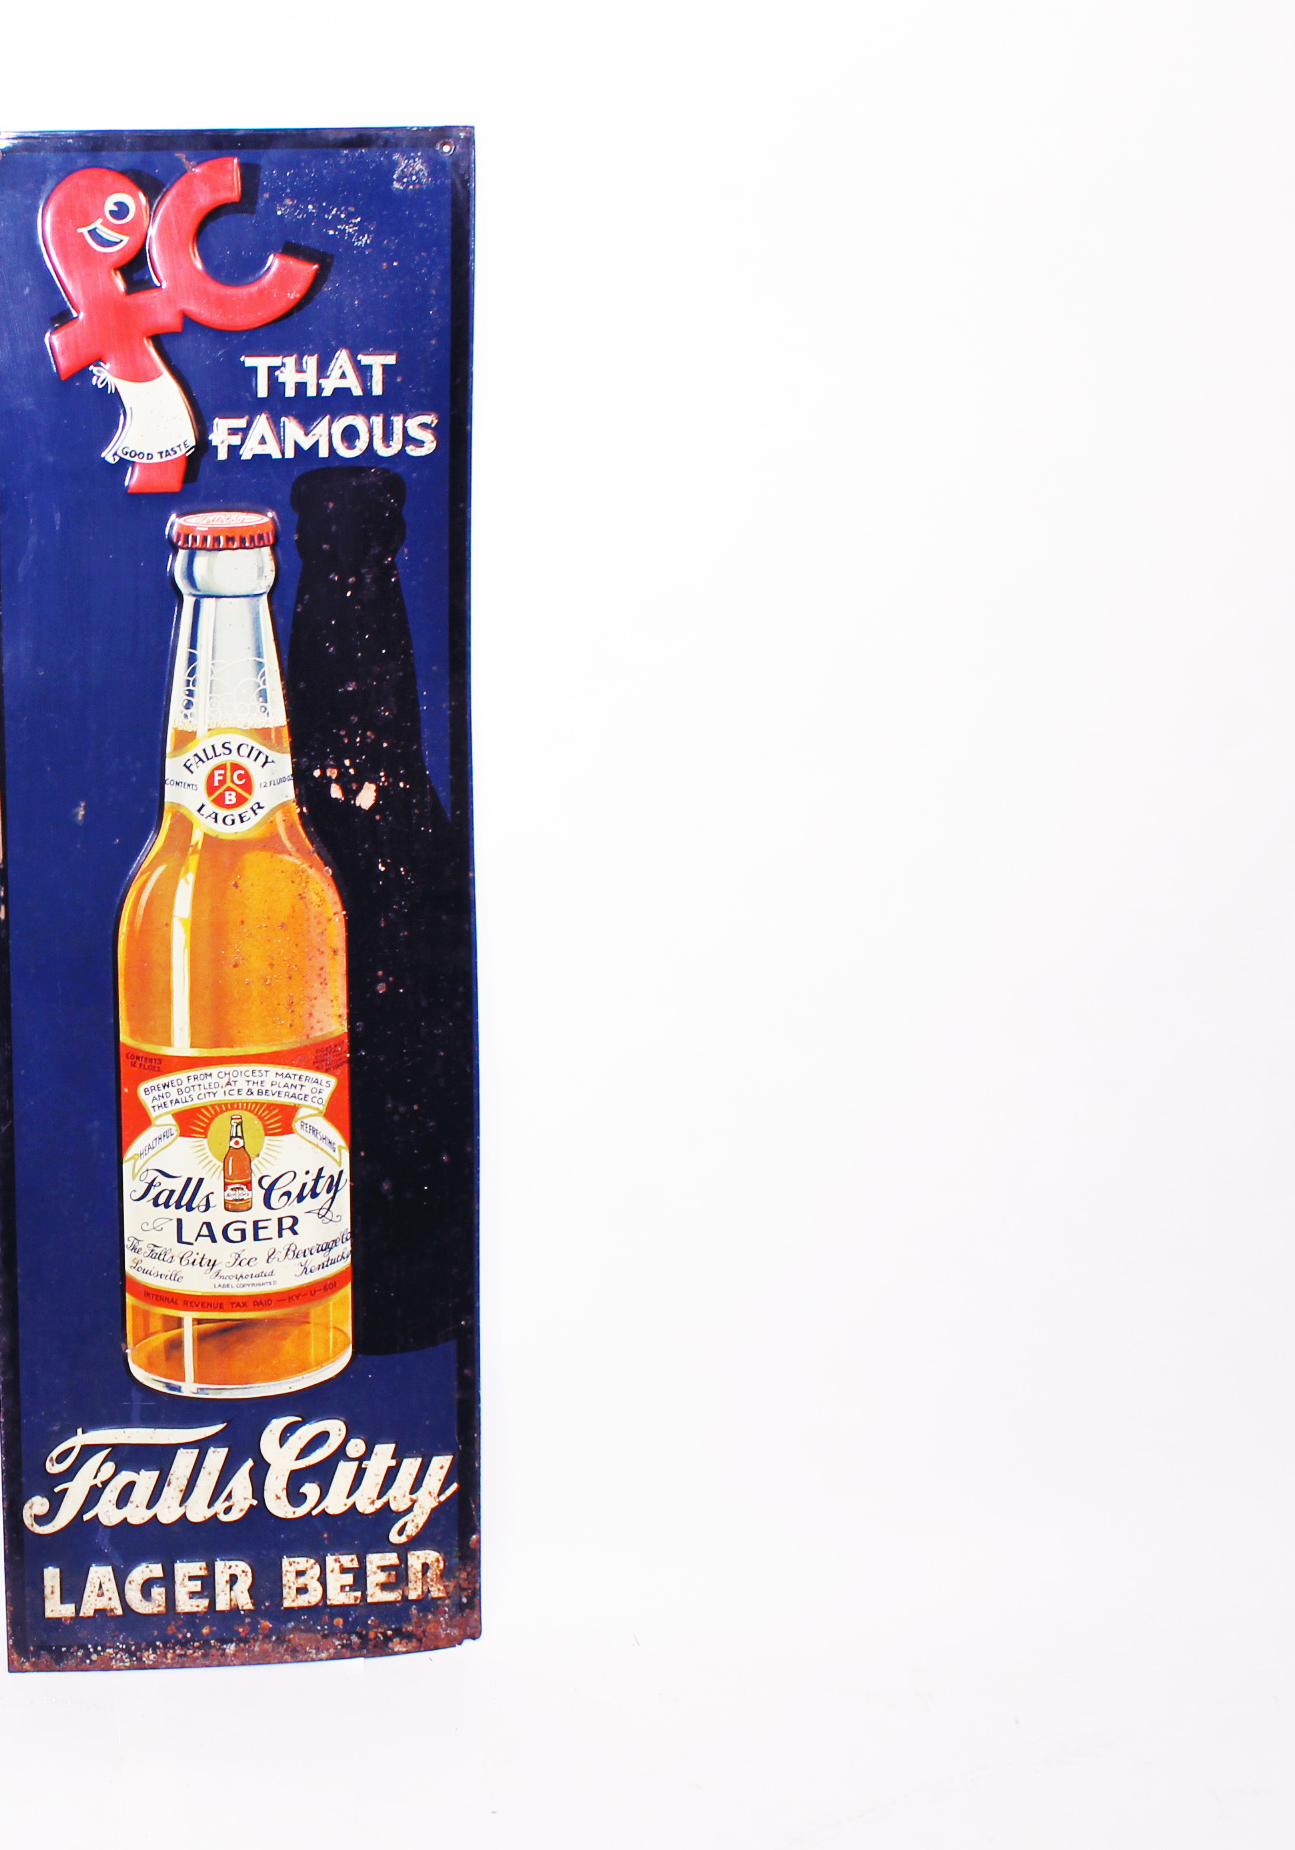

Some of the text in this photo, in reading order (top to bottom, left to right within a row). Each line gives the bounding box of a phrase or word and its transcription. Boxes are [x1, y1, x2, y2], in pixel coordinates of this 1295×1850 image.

[240, 348, 397, 399] THAT
[208, 411, 439, 461] FAMOUS
[121, 440, 191, 461] GOOD TASTE
[183, 741, 276, 775] FALLS CITY
[165, 777, 199, 792] CONTENTS
[259, 781, 269, 789] 12
[269, 776, 287, 788] FLUID
[196, 801, 266, 827] LAGER
[126, 1051, 163, 1065] CONTENTS
[143, 1069, 332, 1096] BREWED FROM CHOICEST MATERIALS
[151, 1091, 172, 1104] AND
[225, 1079, 239, 1088] AT
[246, 1079, 266, 1088] THE
[270, 1080, 306, 1091] PLANT
[310, 1086, 325, 1096] OF
[151, 1101, 170, 1113] THE
[169, 1094, 194, 1108] FALLS
[196, 1090, 219, 1101] CITY
[223, 1088, 244, 1097] ICE
[246, 1088, 255, 1097] &
[257, 1088, 310, 1102] BEVERAGE
[138, 1127, 175, 1161] HEALTHFUL
[299, 1120, 338, 1154] REFRESHING
[130, 1166, 348, 1219] Falls City
[176, 1215, 300, 1246] LAGER
[126, 1236, 144, 1255] The
[143, 1243, 176, 1264] Falls
[178, 1250, 222, 1275] City
[225, 1249, 258, 1268] Ice
[265, 1247, 278, 1264] &
[277, 1236, 341, 1263] Beverage
[130, 1258, 184, 1283] Louisville
[209, 1269, 275, 1282] Incorporated
[213, 1280, 278, 1290] LABEL COPYRIGHTED
[143, 1290, 179, 1306] INTERNAL
[182, 1299, 224, 1310] REVENUE
[229, 1301, 248, 1309] TAX
[252, 1299, 273, 1309] PAID
[22, 1415, 460, 1545] Falls City
[42, 1549, 449, 1619] LAGER BEER
